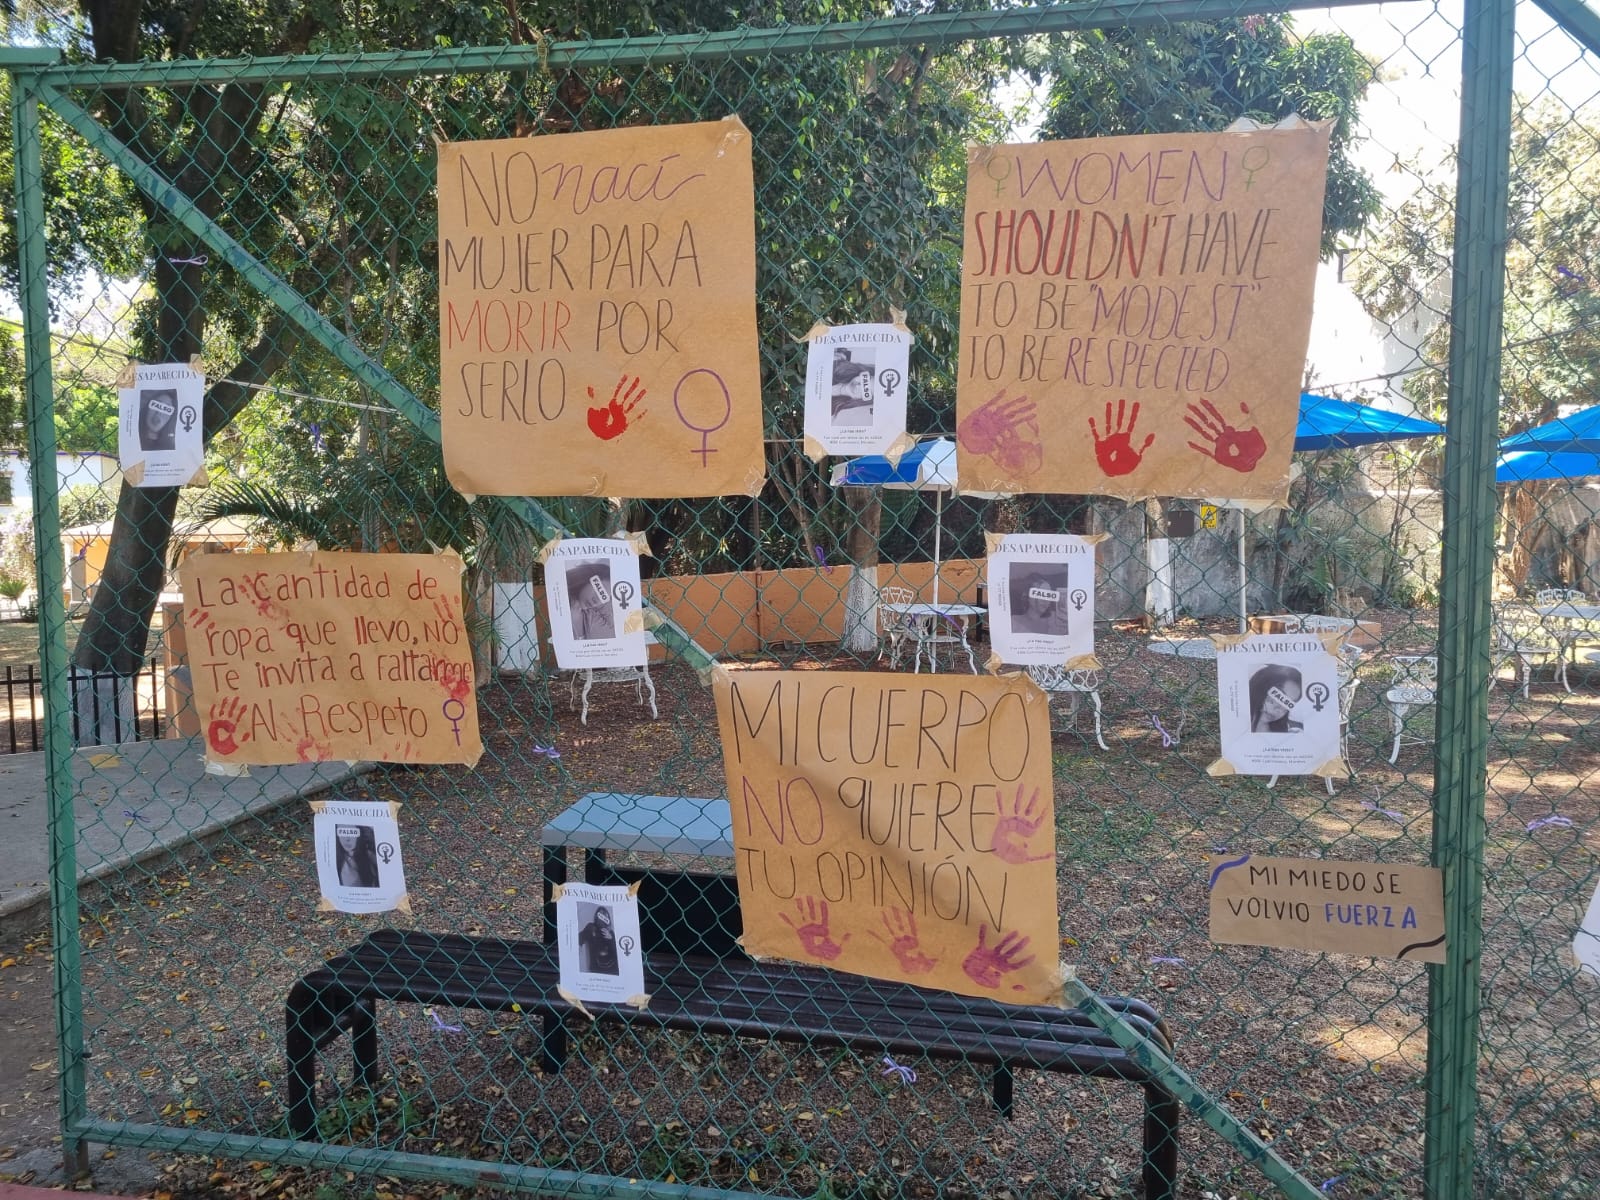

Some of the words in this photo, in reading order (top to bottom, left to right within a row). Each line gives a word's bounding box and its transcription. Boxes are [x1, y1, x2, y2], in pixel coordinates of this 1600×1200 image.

[459, 151, 538, 227] NO
[541, 153, 706, 215] nací
[1016, 149, 1228, 205] WOMEN
[444, 228, 574, 293] MUJER
[589, 219, 702, 291] PARA
[971, 209, 1176, 281] SHOULDN'T
[1180, 208, 1281, 280] HAVE
[969, 280, 1018, 328] TO
[1034, 282, 1078, 331] BE
[447, 299, 572, 354] MORIR
[596, 298, 680, 355] POR
[815, 333, 902, 345] DESAPARECIDA
[968, 334, 1005, 381] TO
[1018, 335, 1058, 383] BE
[1064, 337, 1230, 393] RESPECTED
[458, 358, 566, 425] SERLO
[862, 374, 870, 398] FALSO
[151, 402, 172, 413] FALSO
[545, 545, 631, 557] DESAPARECIDA
[994, 543, 1086, 554] DESAPARECIDA
[196, 577, 238, 608] La
[253, 563, 390, 601] cantidad
[407, 569, 437, 601] de
[592, 577, 608, 601] FALSO
[1031, 589, 1057, 599] FALSO
[205, 626, 275, 661] ropa
[1223, 641, 1327, 653] DESAPARECIDA
[202, 662, 240, 693] Te
[255, 652, 335, 688] invita
[350, 652, 364, 681] a
[1271, 690, 1295, 709] FALSO
[300, 694, 428, 745] Respeto
[731, 679, 801, 766] MI
[817, 685, 1030, 782] CUERPO
[316, 806, 390, 818] DESAPARECIDA
[742, 775, 824, 846] NO
[560, 888, 630, 902] DESAPARECIDA
[739, 847, 797, 900] TU
[816, 851, 1008, 933] OPINIÓN
[1250, 865, 1277, 886] MI
[1289, 869, 1366, 892] MIEDO
[1373, 872, 1401, 894] SE
[1227, 897, 1310, 923] VOLVIO
[1324, 903, 1417, 929] FUERZA
